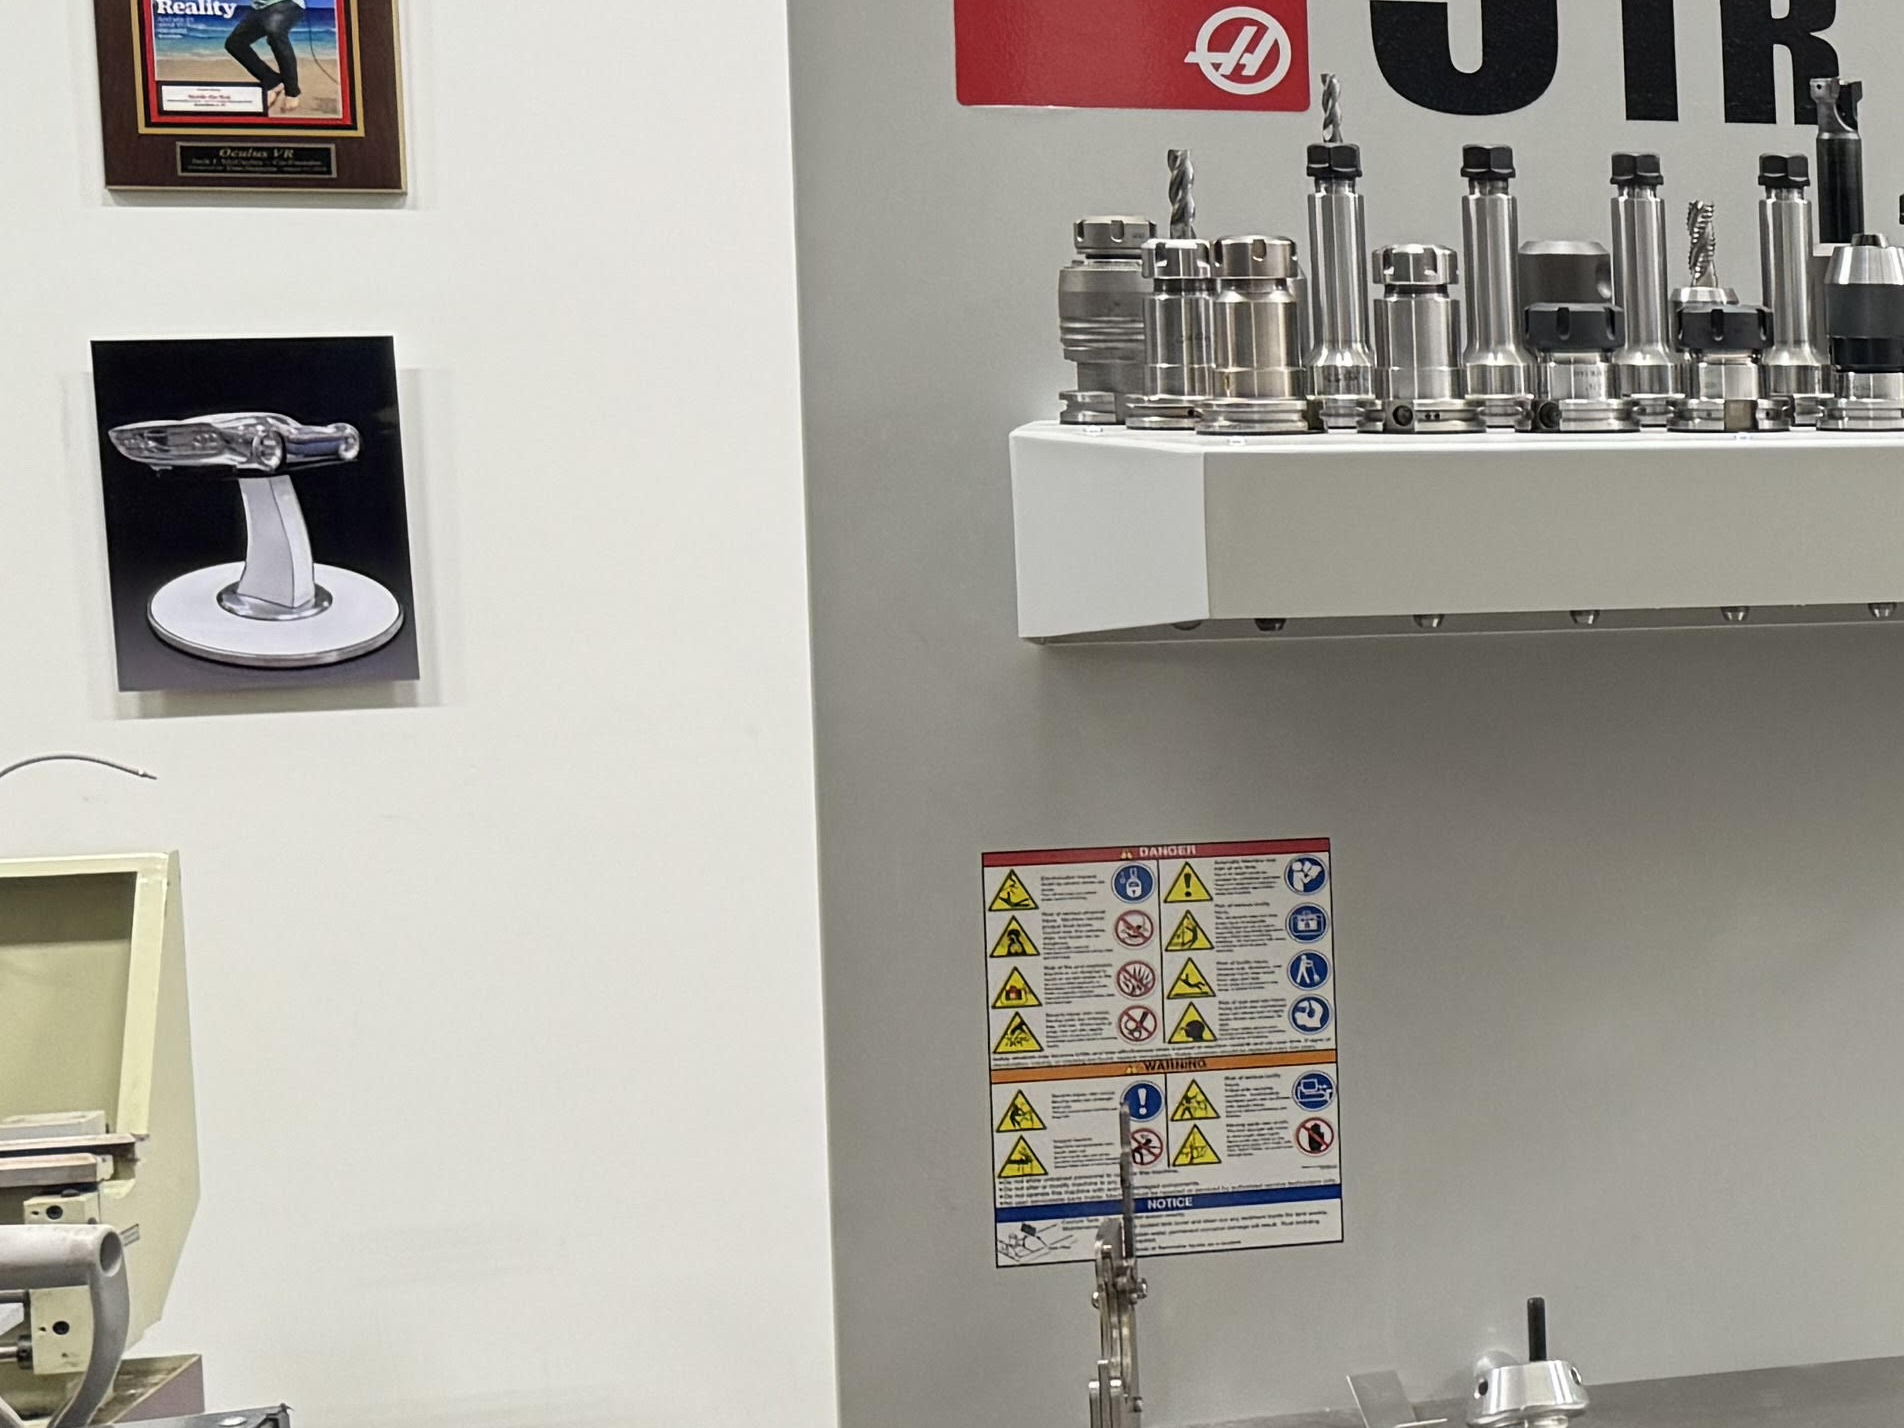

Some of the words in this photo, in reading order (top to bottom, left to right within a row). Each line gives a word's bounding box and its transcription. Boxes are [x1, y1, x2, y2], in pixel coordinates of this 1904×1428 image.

[218, 147, 268, 159] Oculus
[1139, 844, 1197, 859] DANGER
[1143, 1058, 1207, 1072] WARNING
[1147, 1196, 1193, 1210] NOTICE
